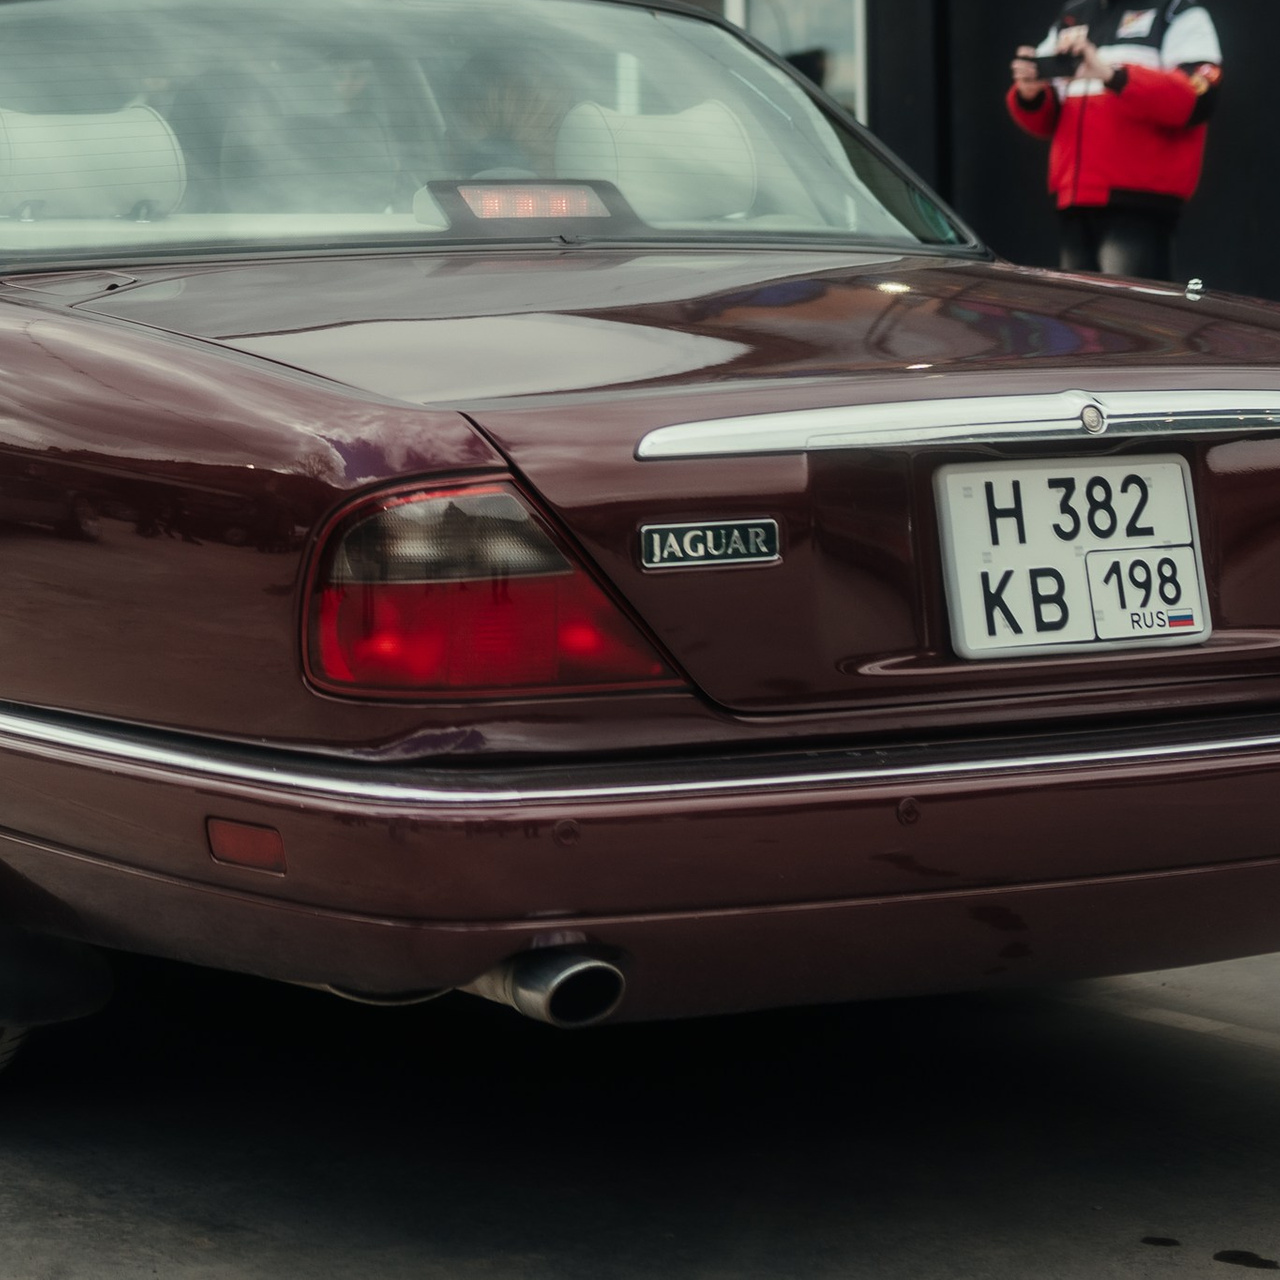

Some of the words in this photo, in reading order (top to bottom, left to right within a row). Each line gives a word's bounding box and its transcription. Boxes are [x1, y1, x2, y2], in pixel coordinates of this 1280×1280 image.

[985, 480, 1026, 545] H
[1047, 474, 1155, 542] 382
[652, 527, 769, 562] JAGUAR
[980, 567, 1070, 636] KB
[1103, 557, 1182, 610] 198
[1130, 611, 1167, 630] RUS
